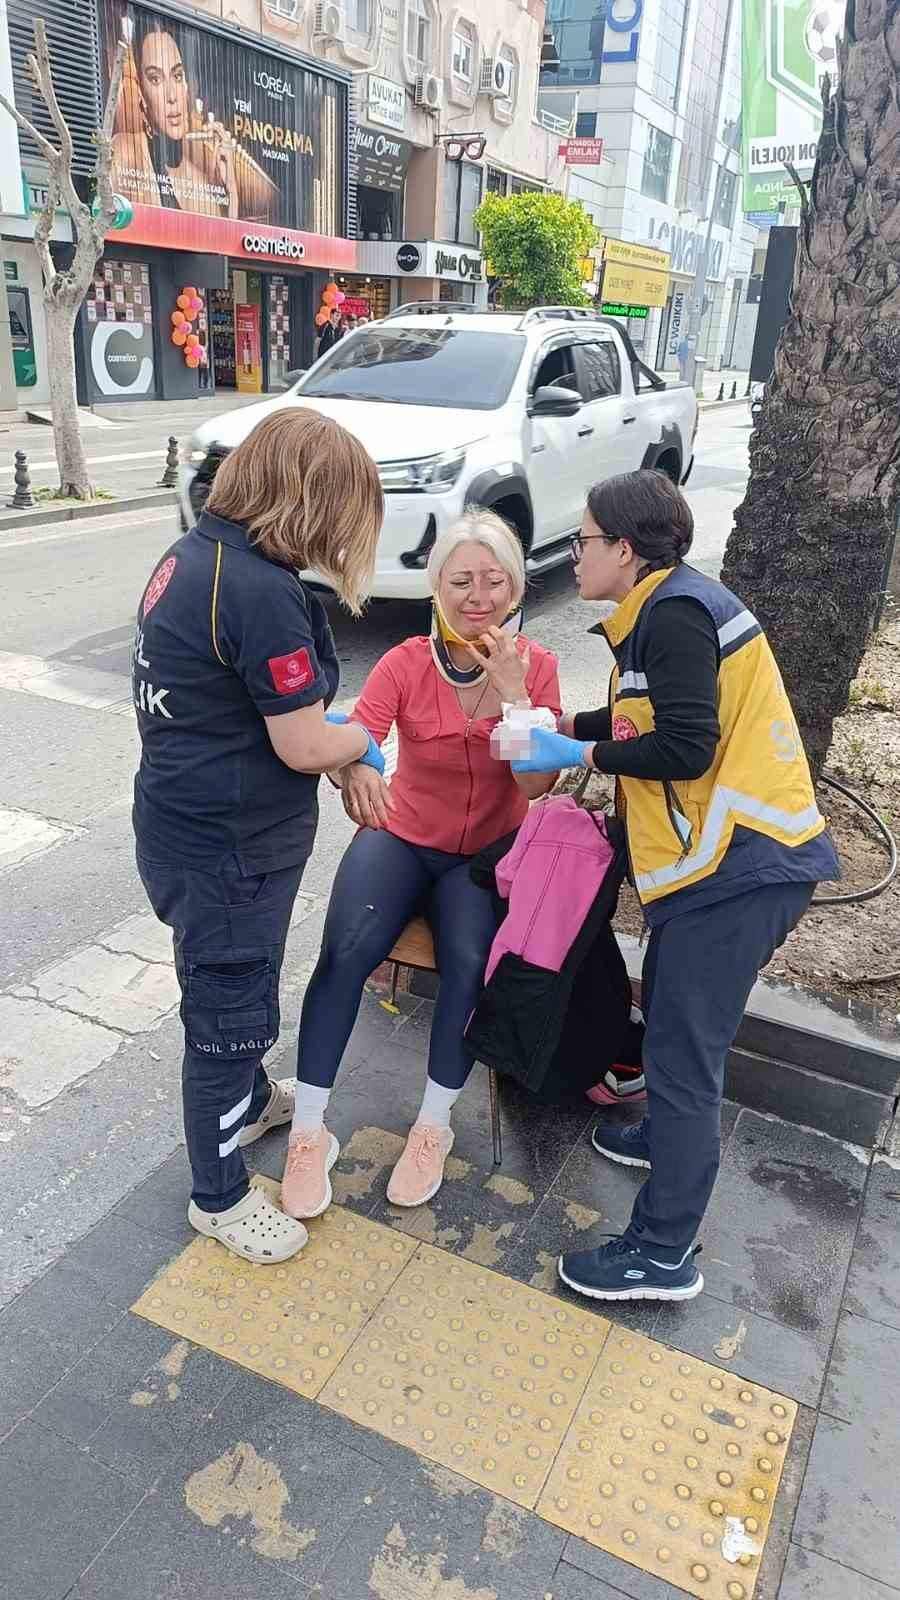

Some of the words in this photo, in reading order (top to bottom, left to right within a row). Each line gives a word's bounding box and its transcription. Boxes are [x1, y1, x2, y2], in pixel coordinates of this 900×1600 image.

[371, 81, 402, 107] AVUKAT
[234, 113, 314, 156] PANORAMA
[262, 148, 289, 163] MASKARA
[567, 147, 600, 156] EMLAK
